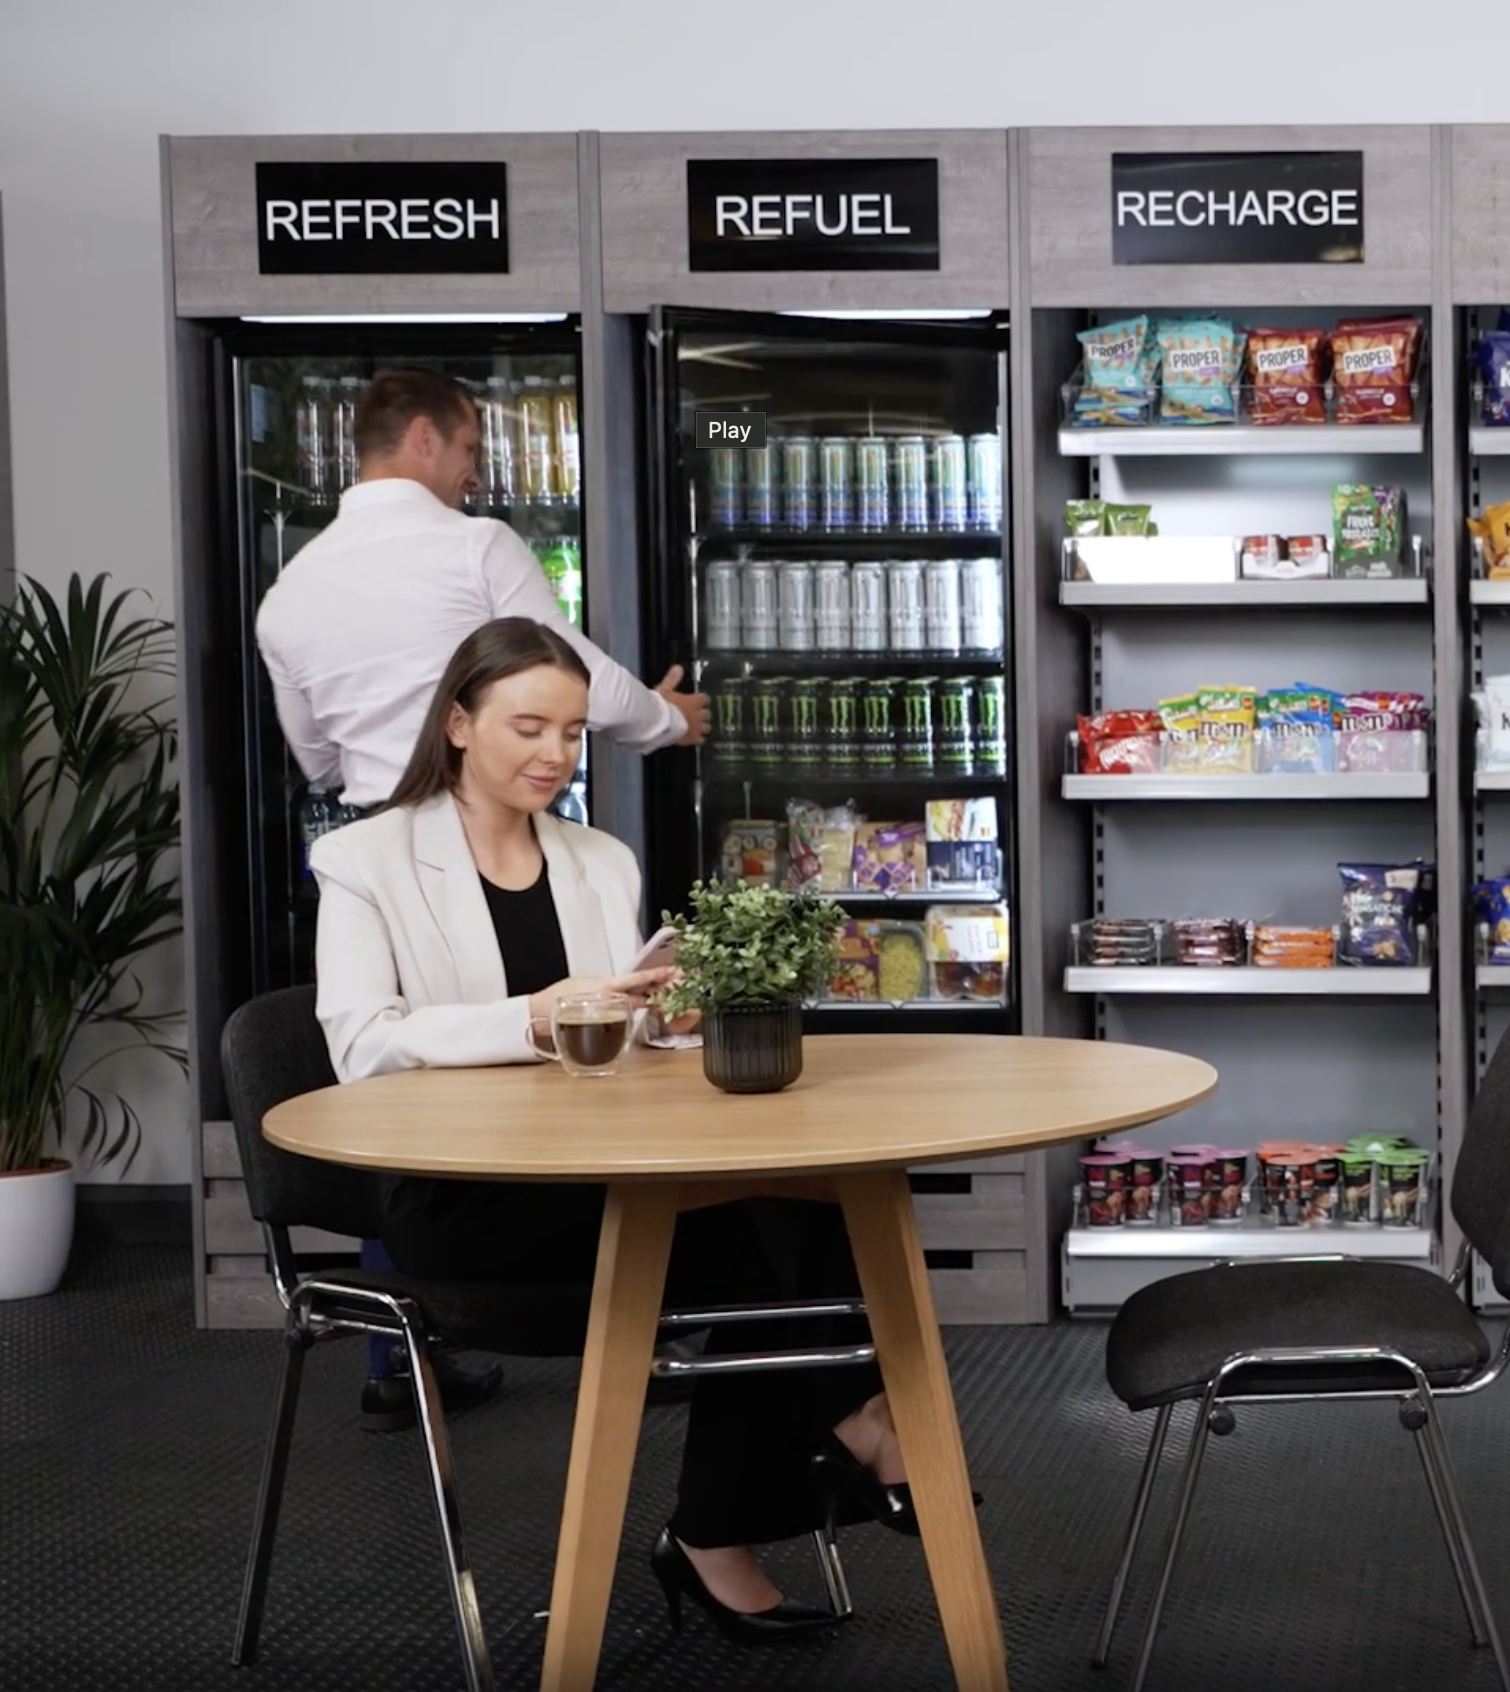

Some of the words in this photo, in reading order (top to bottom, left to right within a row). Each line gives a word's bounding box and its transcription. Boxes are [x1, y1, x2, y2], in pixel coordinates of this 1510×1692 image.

[264, 198, 501, 241] REFRESH
[714, 194, 911, 237] REFUEL
[1116, 189, 1358, 228] RECHARGE
[1091, 337, 1135, 359] PROPER
[1172, 350, 1221, 368] PROPER
[1258, 347, 1306, 369] PROPER
[1344, 348, 1393, 370] PROPER
